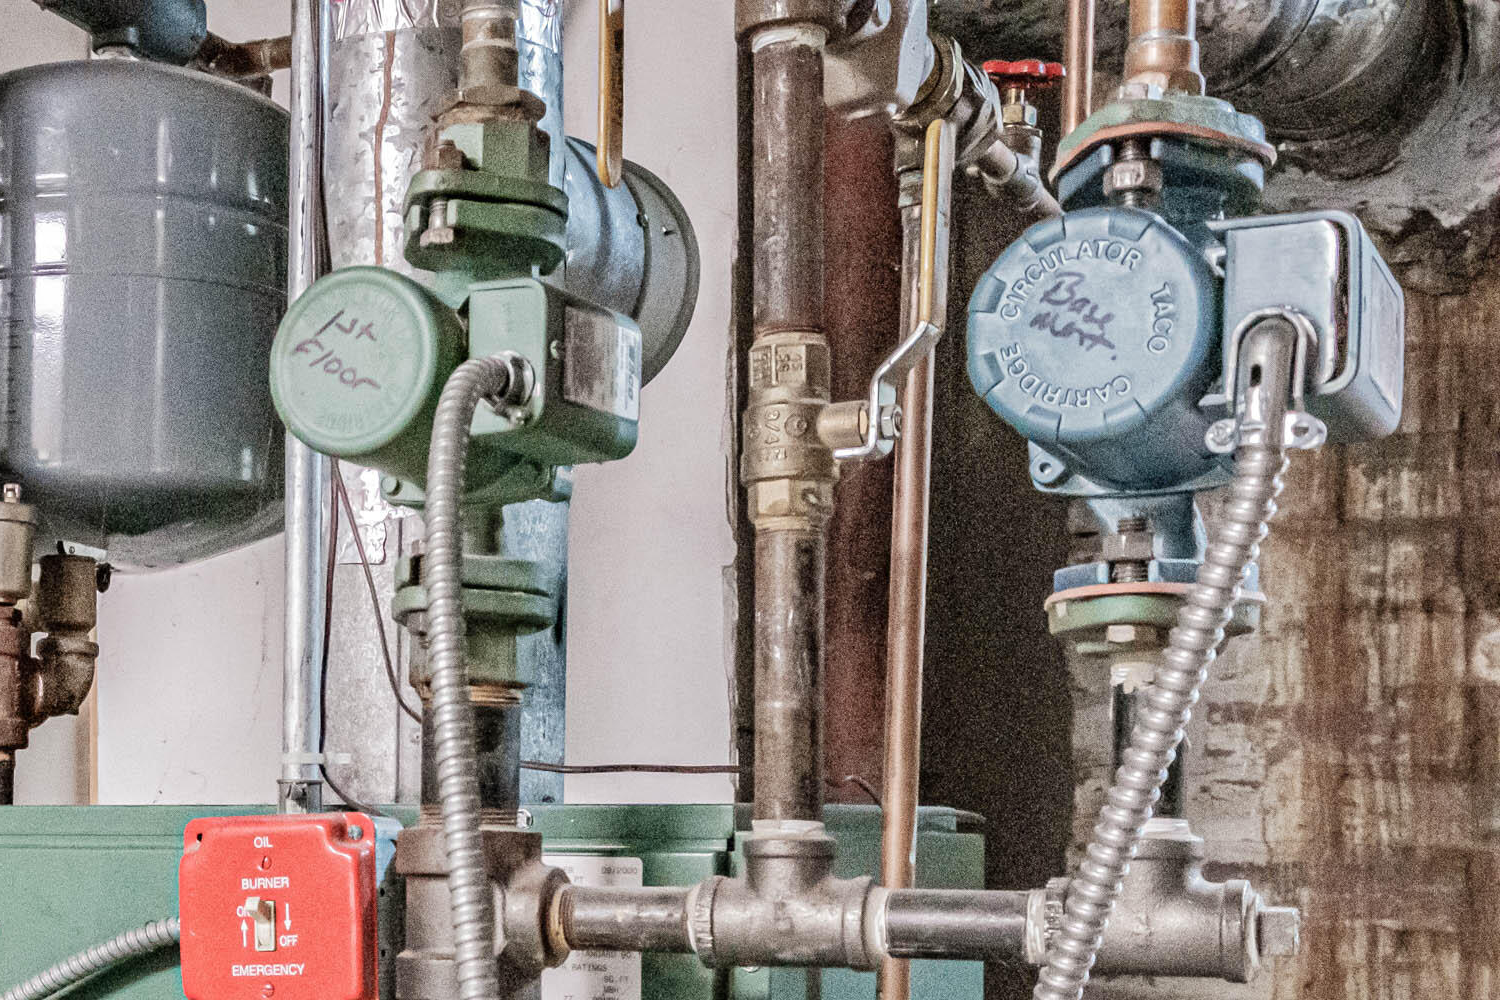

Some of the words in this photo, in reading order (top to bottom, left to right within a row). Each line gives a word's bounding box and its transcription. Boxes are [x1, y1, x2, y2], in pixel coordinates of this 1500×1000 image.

[1000, 240, 1143, 321] CIRCULATOR
[1146, 281, 1175, 354] TACO
[1000, 342, 1132, 408] CARTRIDGE
[253, 836, 273, 849] OIL
[241, 876, 290, 891] BURNER
[279, 935, 299, 947] OFF
[231, 963, 305, 977] EMERGENCY
